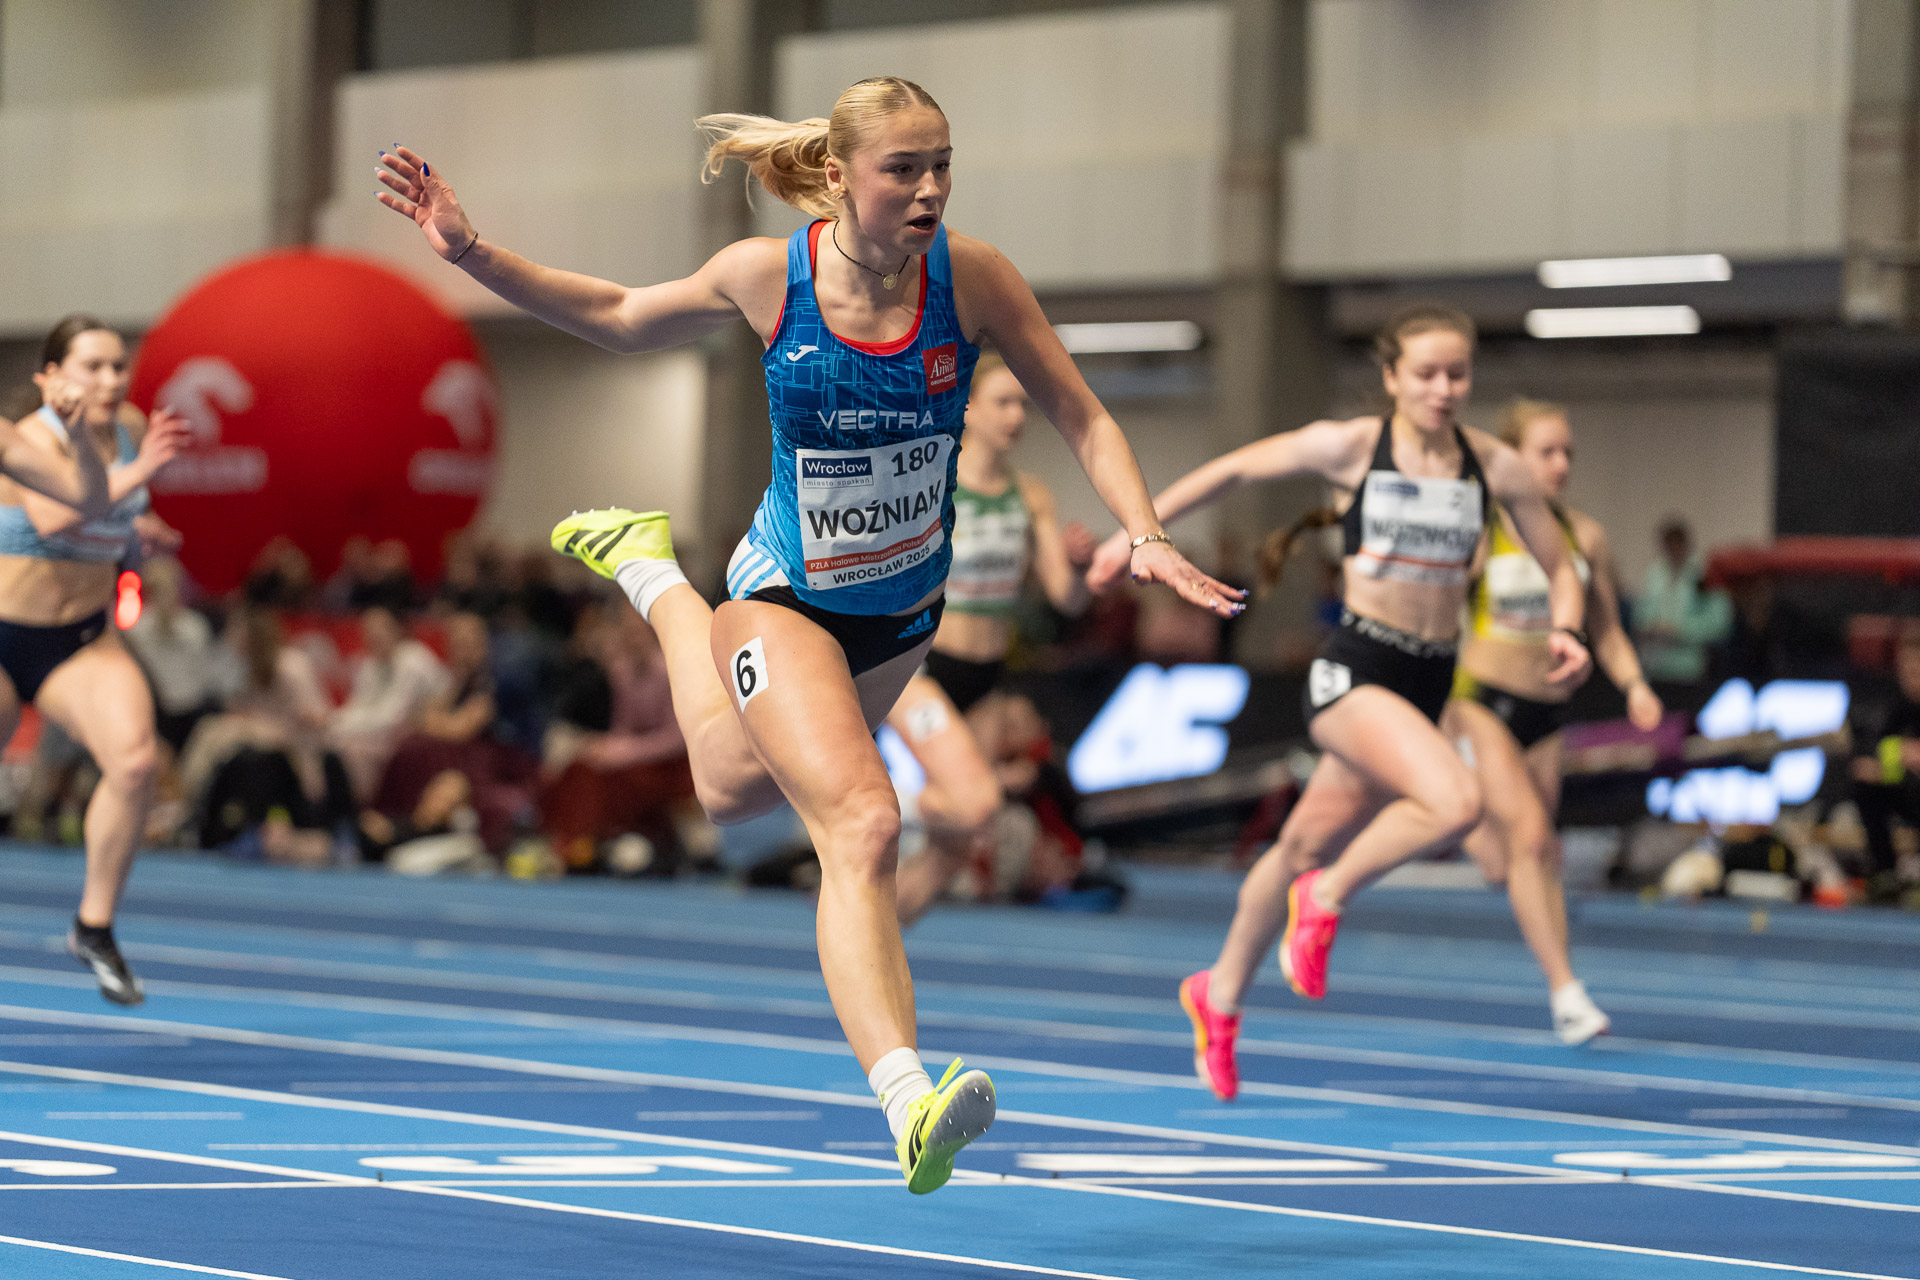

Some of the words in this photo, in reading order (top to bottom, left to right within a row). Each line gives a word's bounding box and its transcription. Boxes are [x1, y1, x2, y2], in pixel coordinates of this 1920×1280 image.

[817, 410, 934, 430] VECTRA
[805, 460, 868, 475] Wrocław
[892, 441, 939, 477] 180
[837, 477, 870, 487] spotkań
[806, 479, 942, 540] WOŹNIAK
[810, 561, 829, 571] PZLA
[830, 555, 860, 568] Halowe
[860, 544, 902, 562] Mistrzostwa
[902, 537, 923, 551] Polski
[833, 557, 904, 585] WROCŁAW
[905, 543, 931, 565] 2025
[736, 649, 757, 698] 6
